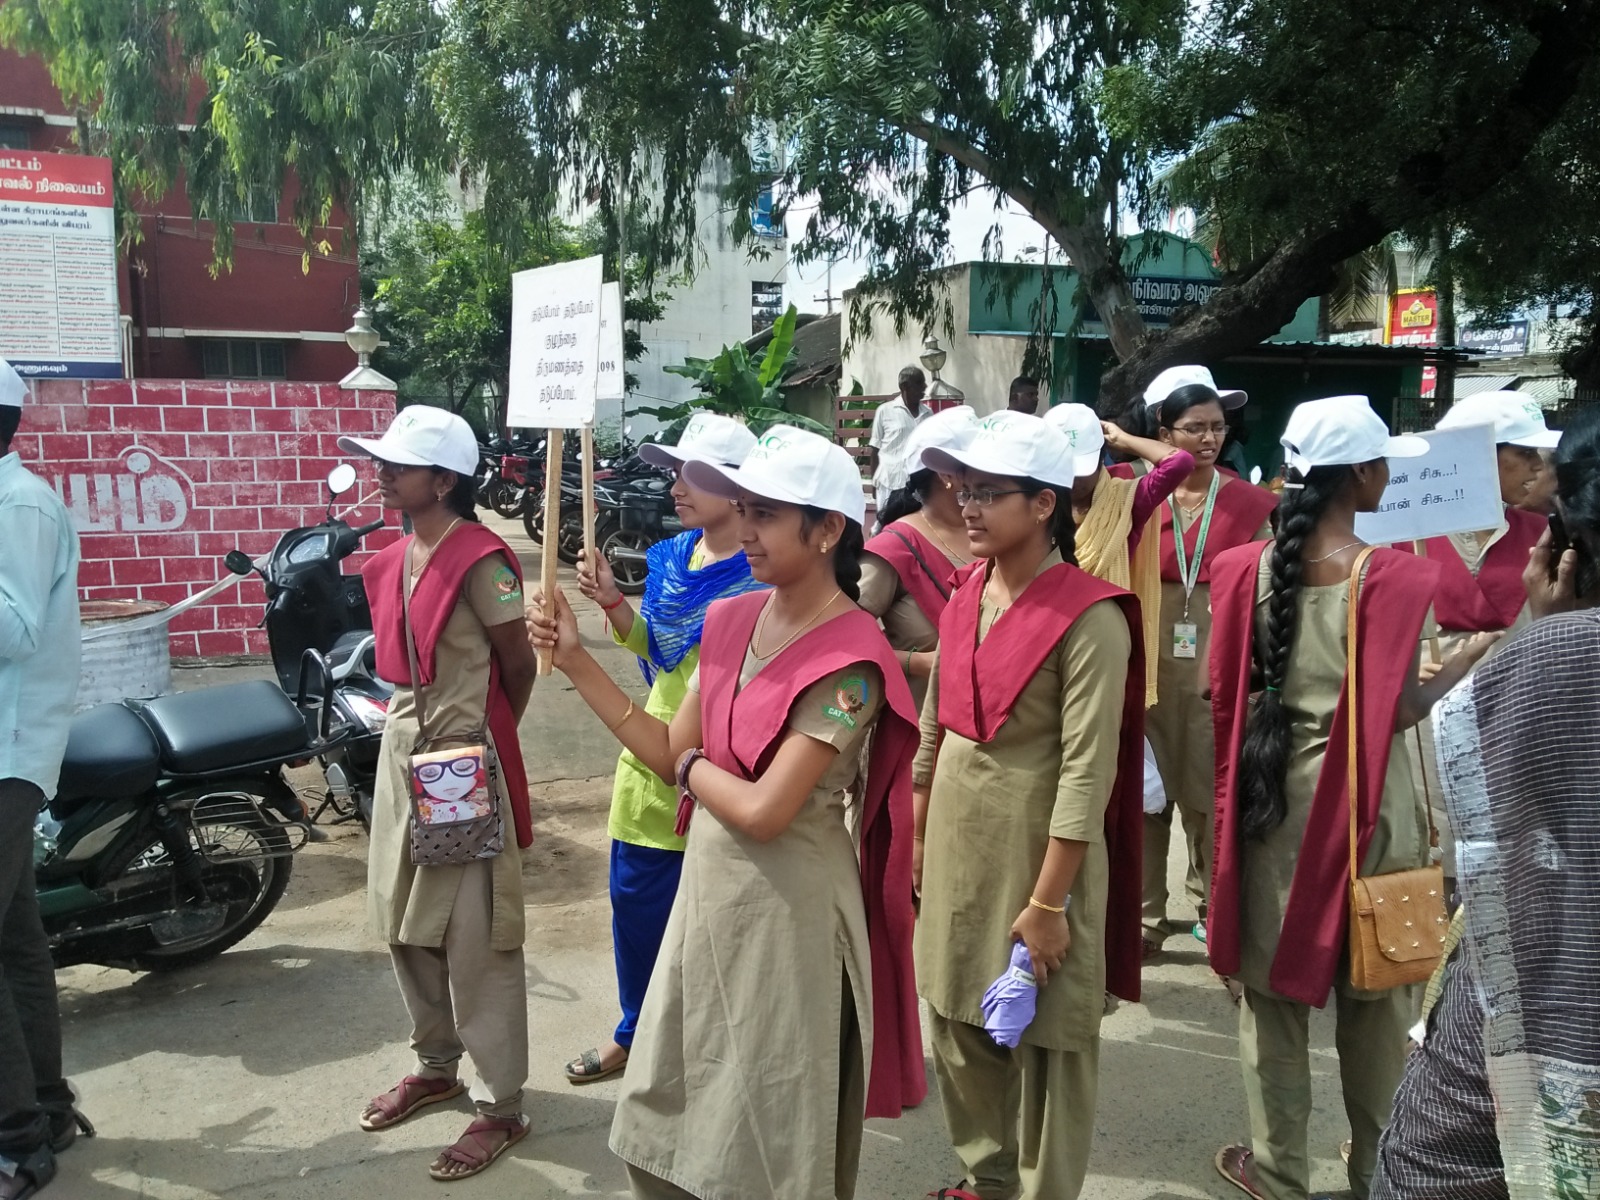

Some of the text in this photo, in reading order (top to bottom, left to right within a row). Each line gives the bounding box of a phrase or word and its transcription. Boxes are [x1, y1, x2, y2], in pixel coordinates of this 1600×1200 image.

[36, 177, 106, 195] நிலையம்
[1403, 314, 1430, 323] MASTER
[598, 361, 616, 373] 098
[55, 452, 187, 533] யம்
[827, 707, 843, 718] CAT
